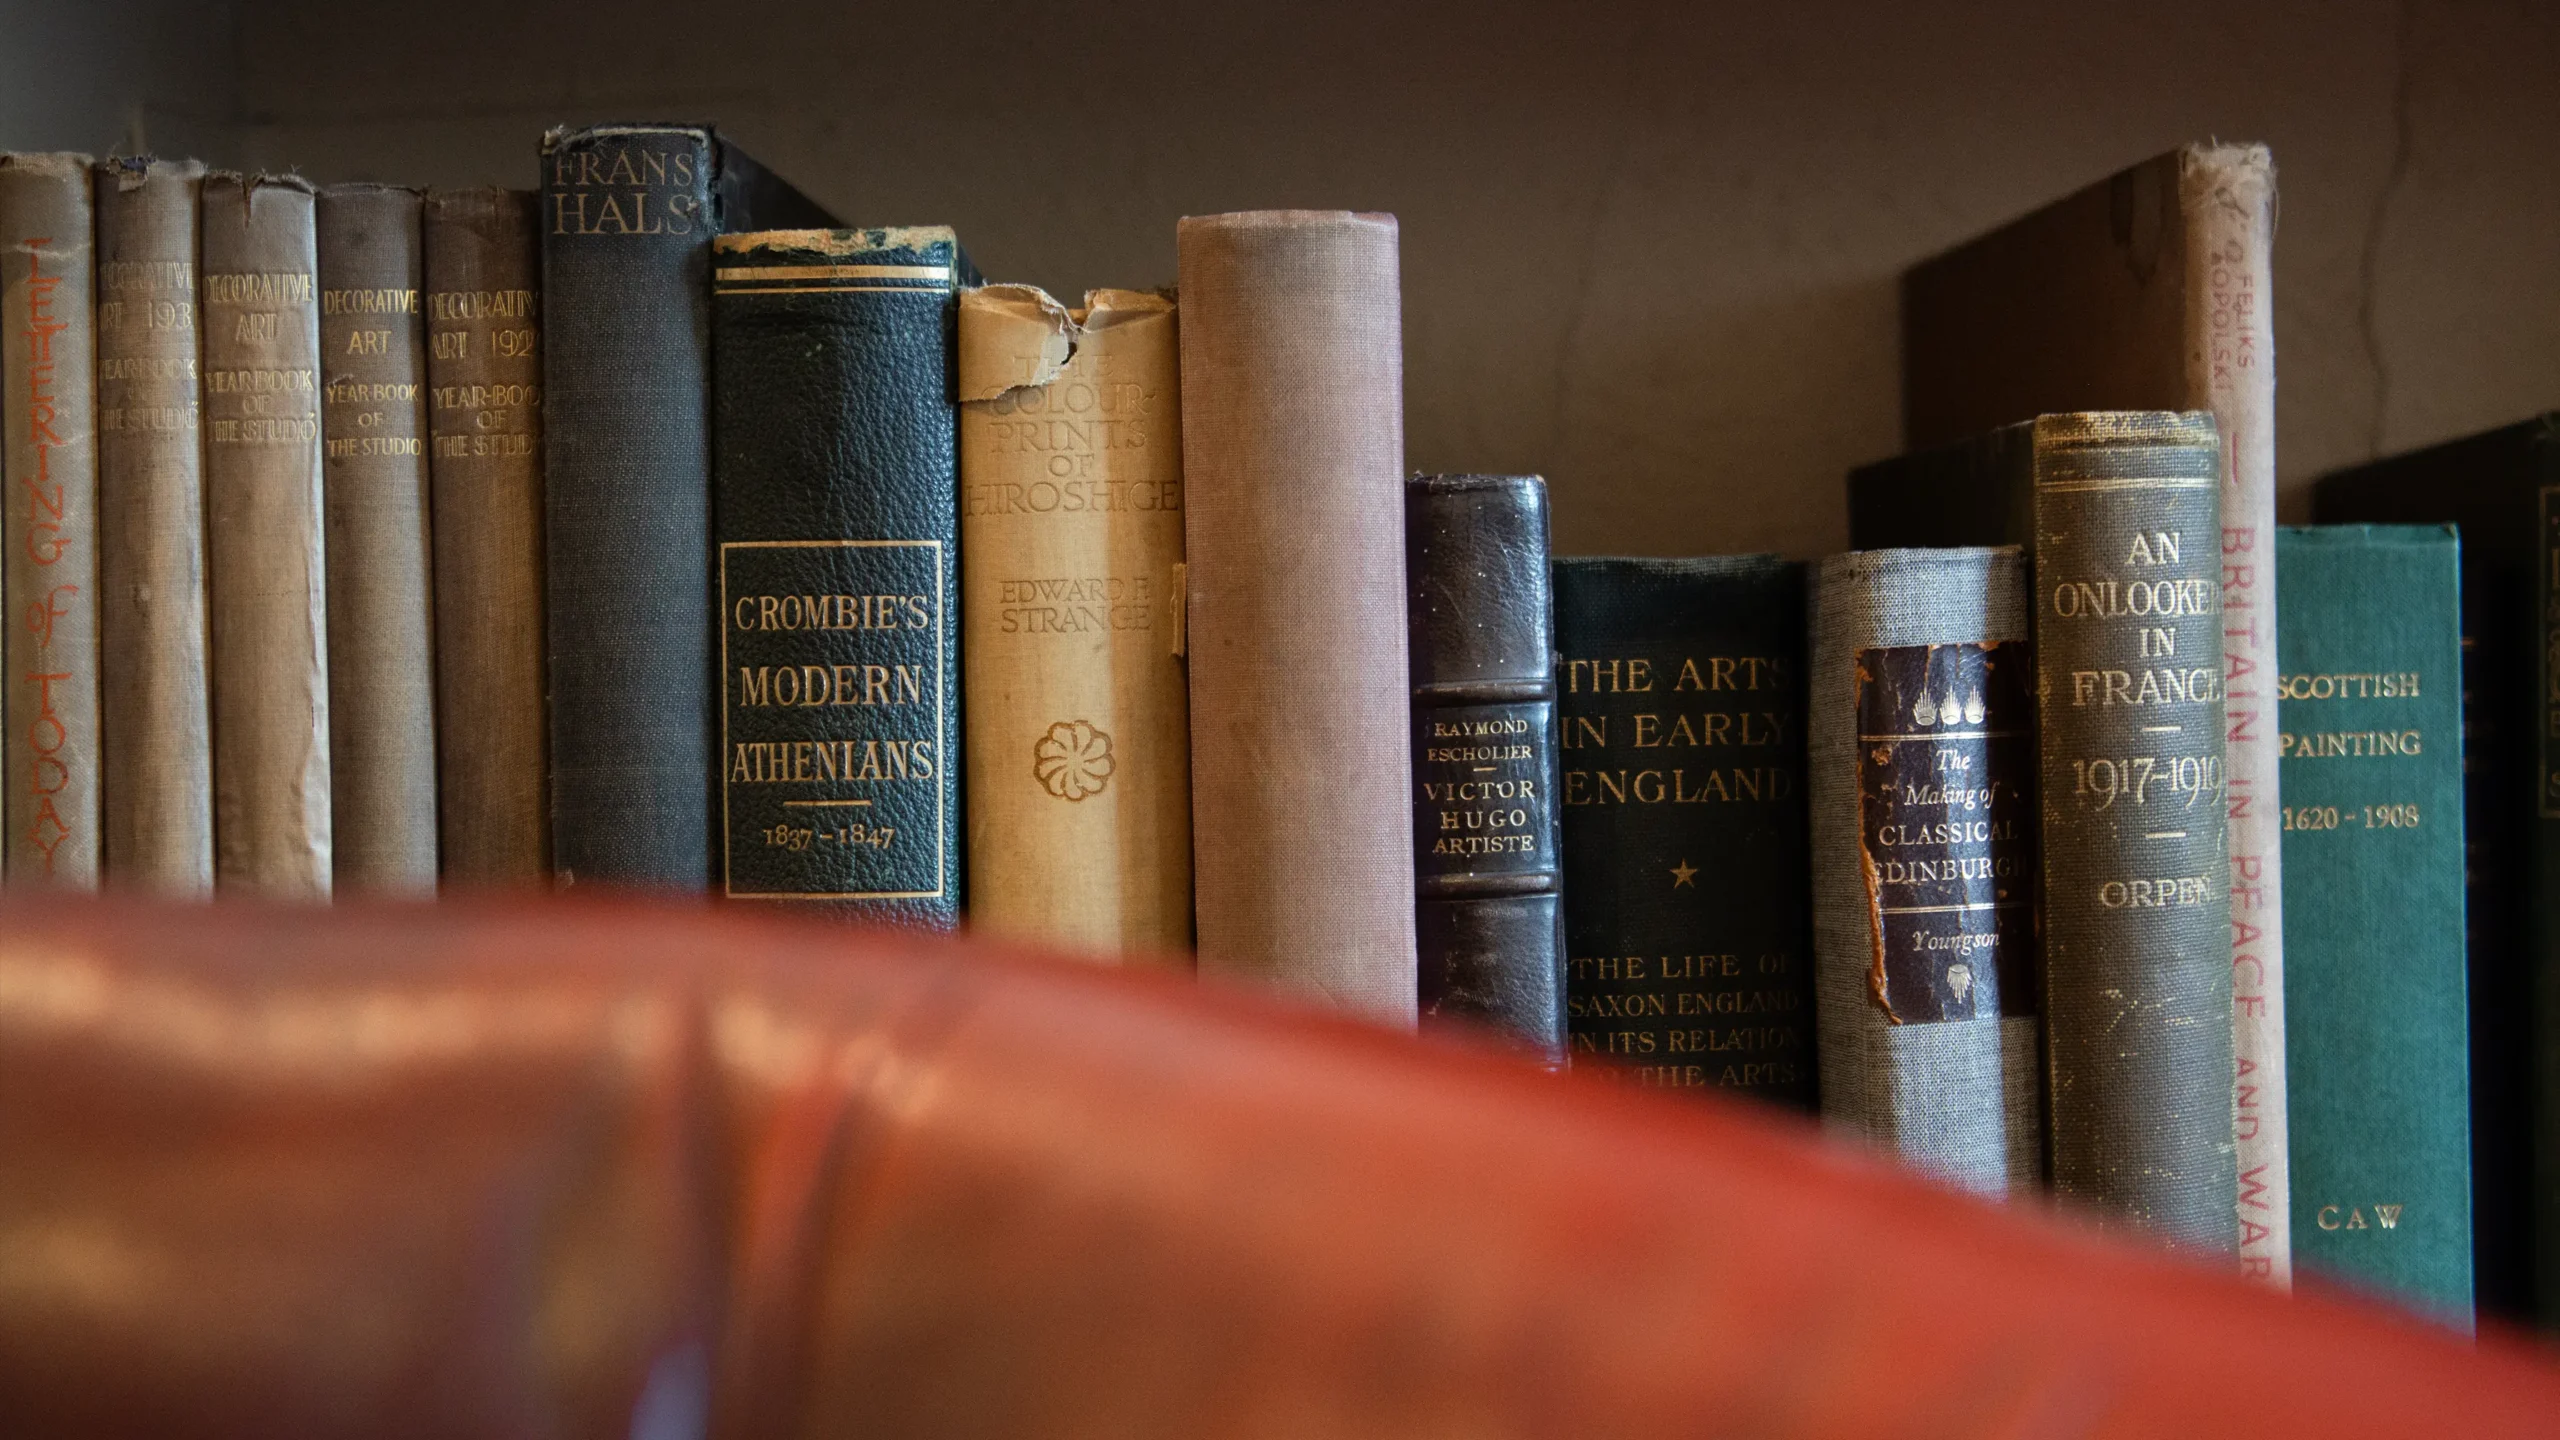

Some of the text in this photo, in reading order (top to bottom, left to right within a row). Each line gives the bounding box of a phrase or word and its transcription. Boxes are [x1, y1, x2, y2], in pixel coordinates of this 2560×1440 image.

[552, 149, 693, 187] FRANS
[552, 191, 697, 236] HALS
[203, 273, 312, 302] DECORATIVE
[324, 289, 419, 315] DECORATIVE
[148, 300, 192, 330] 193
[427, 290, 539, 320] DECORATIV
[235, 313, 277, 341] ART
[2211, 253, 2234, 390] OPOLSKI
[346, 330, 392, 354] ART
[431, 330, 540, 359] ART 192
[20, 237, 71, 565] LETTERING
[242, 394, 271, 413] OF
[432, 385, 541, 408] YEAR-BOO
[358, 412, 384, 428] OF
[476, 410, 508, 429] OF
[326, 437, 422, 457] THE STUDIO
[473, 434, 535, 456] STUD
[989, 419, 1148, 453] PRINTS
[1049, 453, 1096, 478] OF
[964, 479, 1179, 517] HIROSHIGE
[2124, 532, 2181, 565] AN
[998, 577, 1125, 604] EDWARD
[2053, 579, 2221, 619] ONLOOKER
[735, 595, 930, 631] CROMBIE'S
[1001, 605, 1151, 634] STRANGE
[2139, 627, 2176, 658] IN
[2222, 527, 2258, 743] BRITAIN
[739, 664, 923, 707] MODERN
[1558, 658, 1653, 694] THE
[2071, 668, 2221, 707] FRANCE
[2277, 673, 2420, 699] SCOTTISH
[1434, 719, 1529, 737] RAYMOND
[1561, 712, 1789, 749] IN EARLY
[1427, 745, 1533, 762] ESCHOLIER
[2278, 730, 2422, 758] PAINTING
[25, 672, 71, 867] TODAY
[730, 740, 934, 783] ATHENIANS
[1935, 748, 1971, 771] The
[1423, 780, 1536, 801] VICTOR
[1562, 768, 1791, 806] ENGLAND
[1903, 781, 2001, 811] Making of
[2072, 756, 2223, 812] 1917-1919
[2228, 779, 2251, 819] IN
[1440, 809, 1527, 830] HUGO
[2282, 806, 2339, 831] 1620
[2364, 803, 2420, 829] 1908
[763, 823, 814, 852] 1837
[839, 822, 897, 849] 1847
[1432, 834, 1536, 854] ARTISTE
[1878, 820, 2019, 847] CLASSICAL
[2100, 876, 2212, 909] ORPEN
[1912, 930, 2000, 956] Youngson
[1570, 956, 1647, 980] THE
[1661, 954, 1741, 980] LIFE
[1567, 990, 1799, 1018] SAXON ENGLAND
[1608, 1031, 1656, 1054] ITS
[1634, 1065, 1706, 1088] THE
[1719, 1061, 1796, 1087] ARTS
[2234, 1056, 2259, 1141] AND
[2237, 1163, 2272, 1280] WAR
